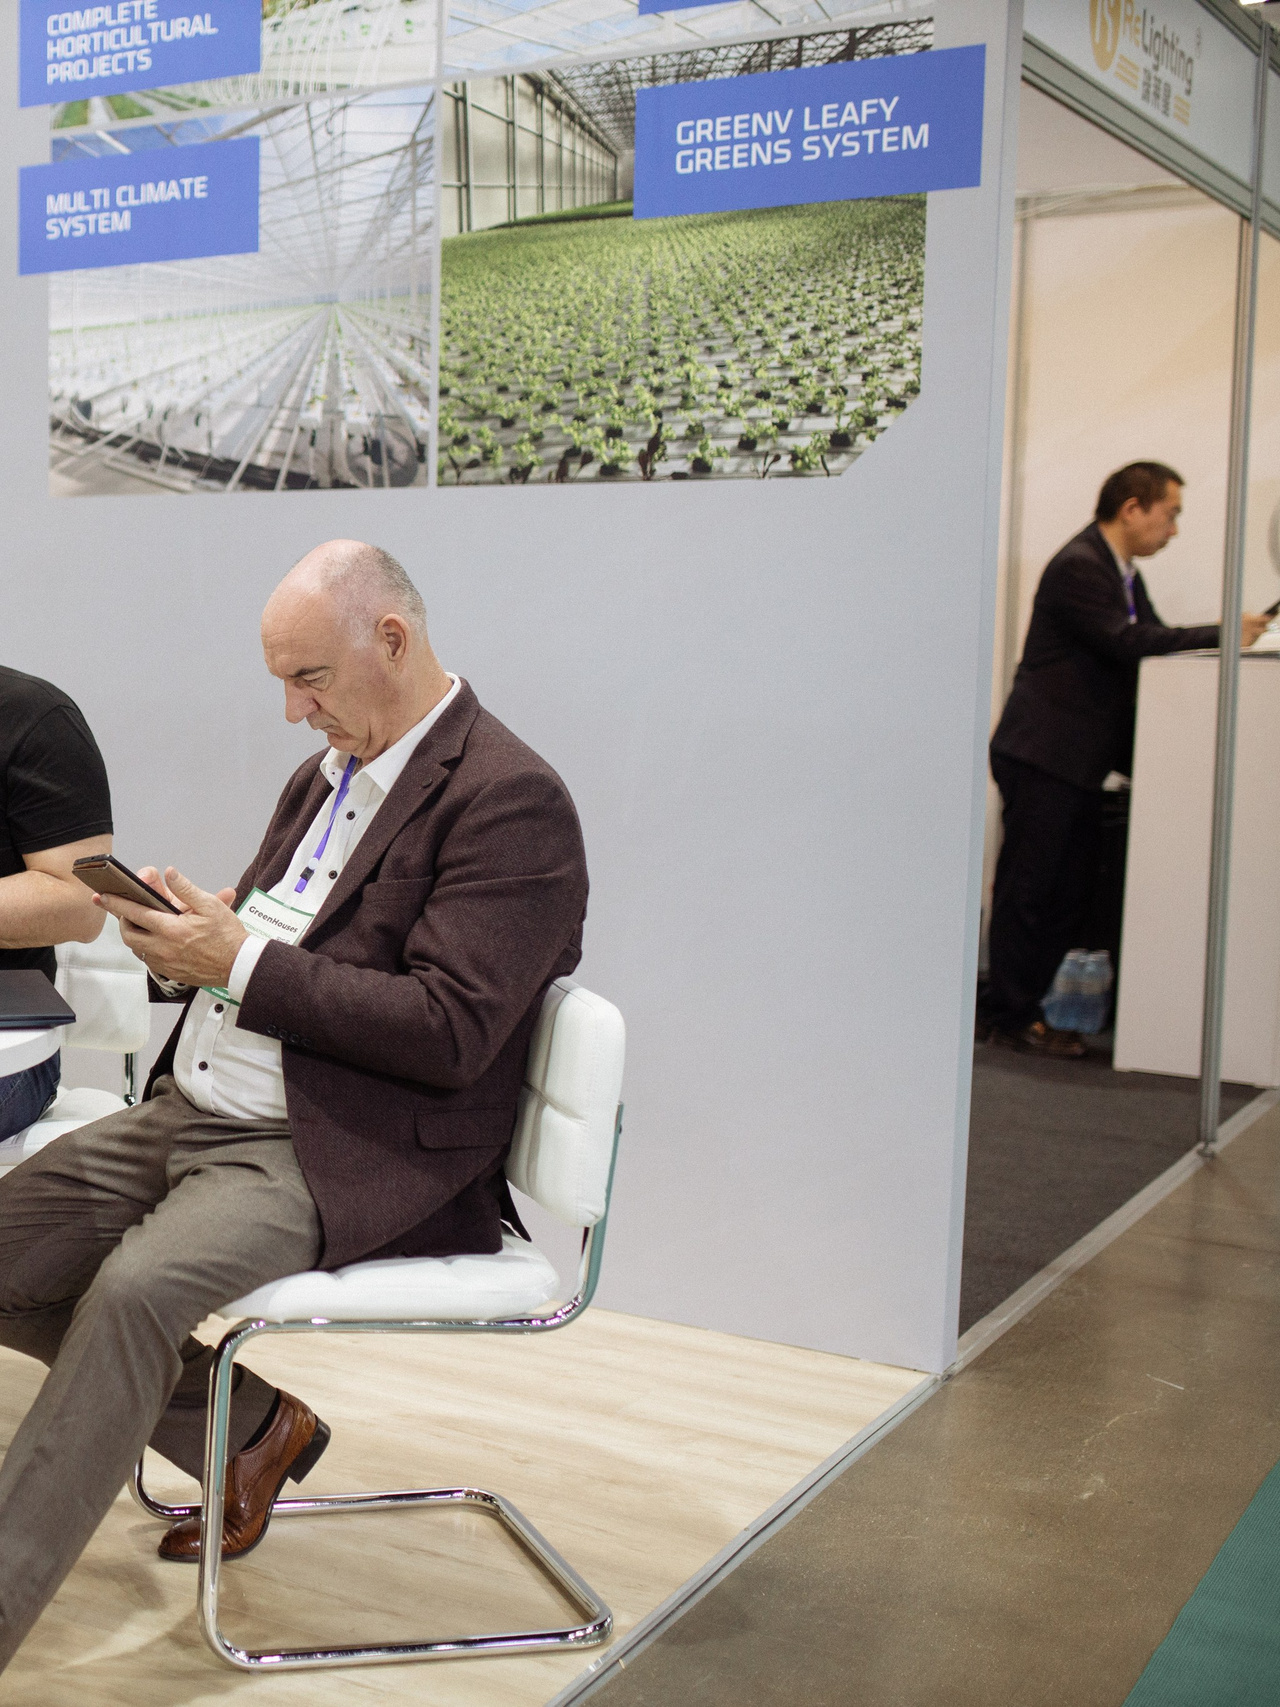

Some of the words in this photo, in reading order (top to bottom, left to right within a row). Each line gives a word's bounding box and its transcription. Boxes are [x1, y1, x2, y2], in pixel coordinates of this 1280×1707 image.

[47, 0, 158, 36] COMPLETE
[47, 13, 219, 61] HORTICULTURAL
[47, 48, 152, 85] PROJECTS
[676, 109, 794, 146] GREENV
[803, 96, 900, 132] LEAFY
[675, 138, 792, 175] GREENS
[802, 123, 930, 162] SYSTEM
[46, 187, 111, 216] MULTI
[115, 175, 209, 208] CLIMATE
[46, 209, 131, 240] SYSTEM
[248, 905, 298, 933] GreenHouses
